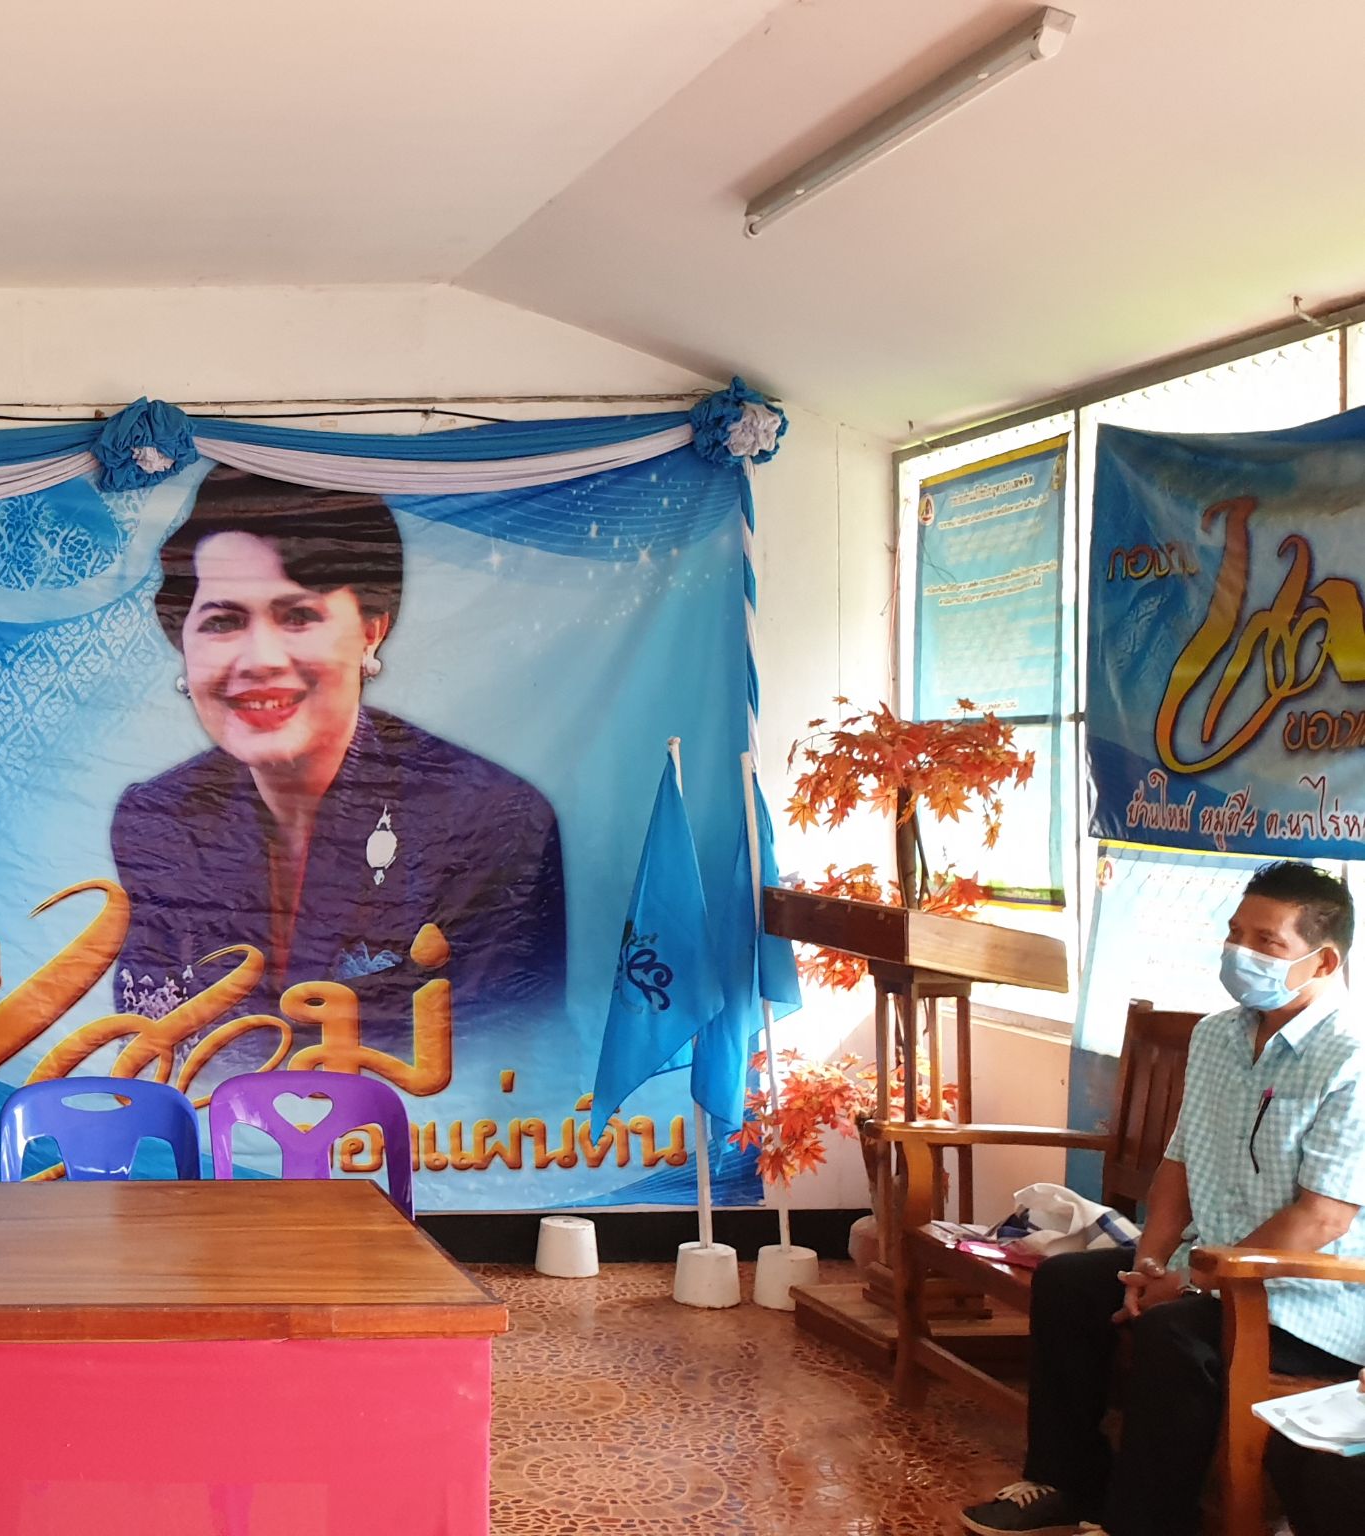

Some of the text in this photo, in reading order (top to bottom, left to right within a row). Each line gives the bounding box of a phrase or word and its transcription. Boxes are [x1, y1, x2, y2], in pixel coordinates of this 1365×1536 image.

[1127, 768, 1196, 832] บ้านใหม่
[1265, 774, 1365, 840] ต.นาไร่ห
